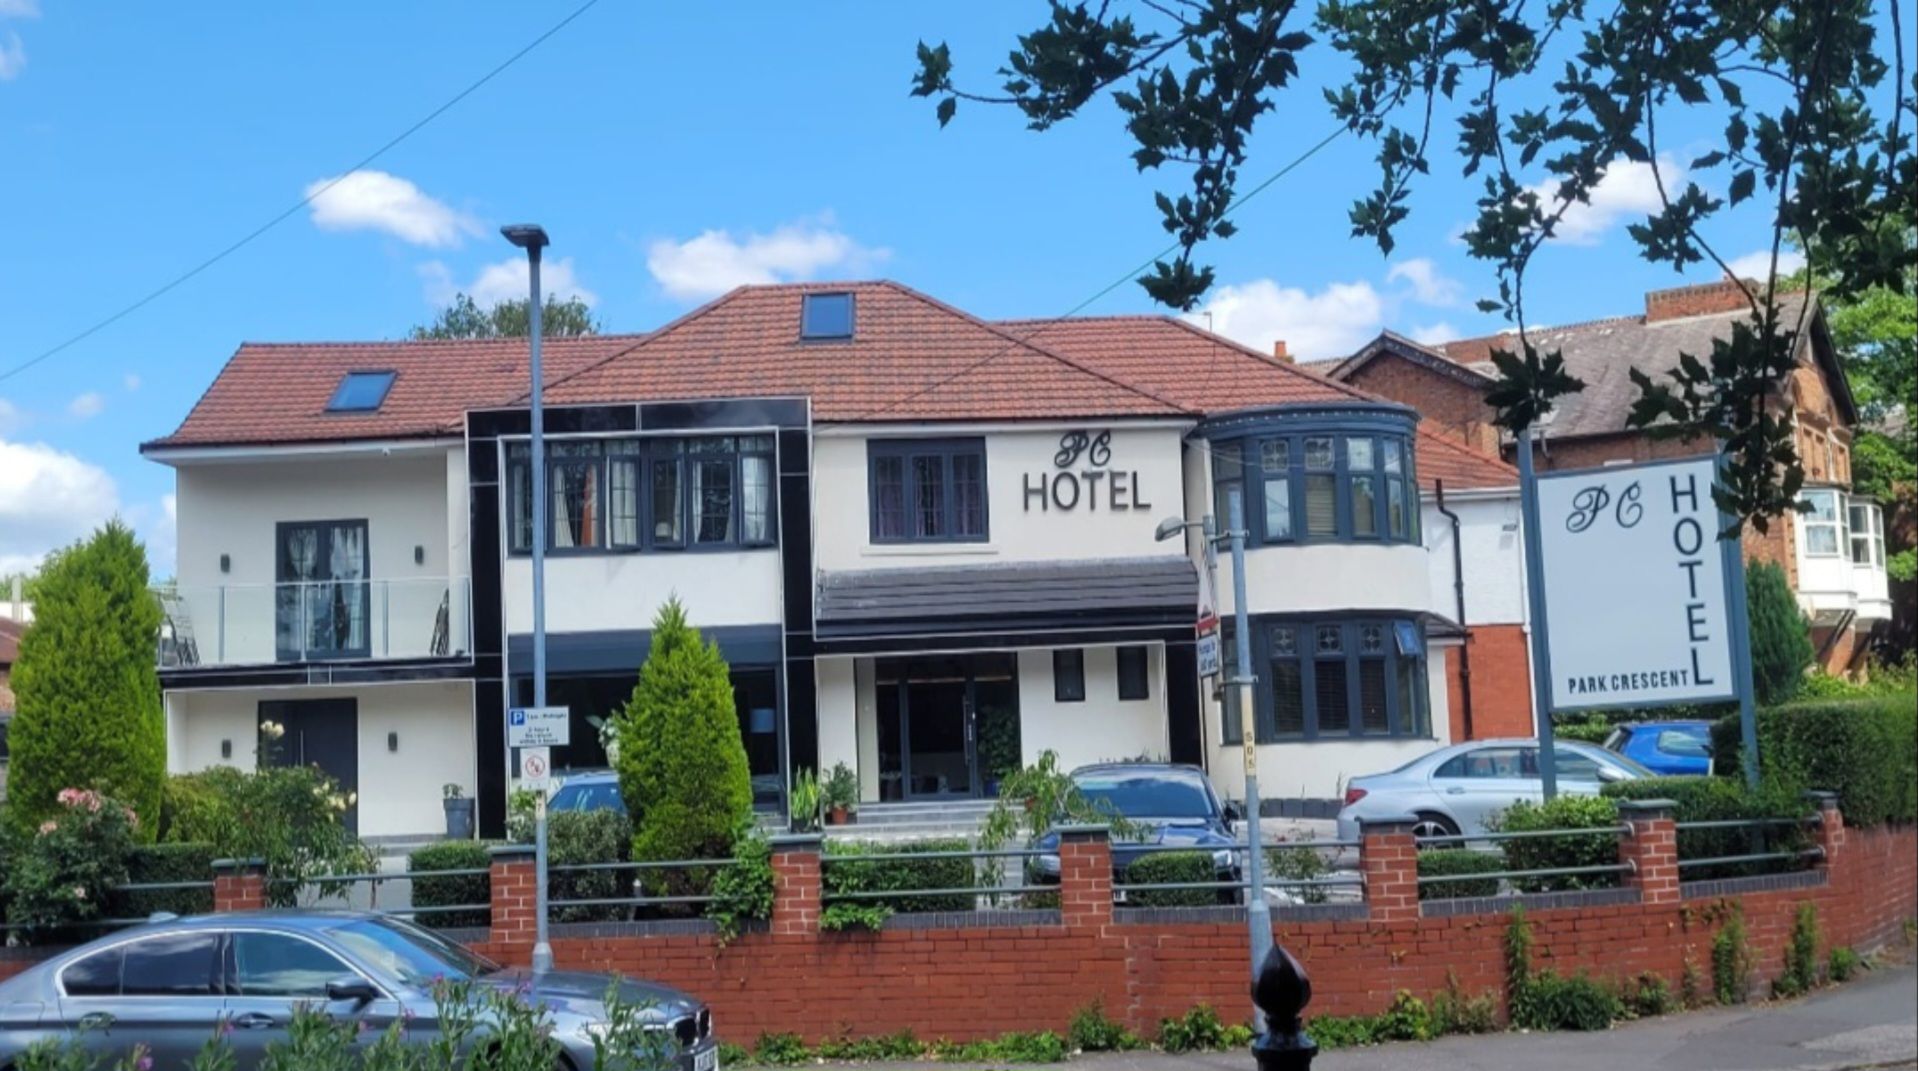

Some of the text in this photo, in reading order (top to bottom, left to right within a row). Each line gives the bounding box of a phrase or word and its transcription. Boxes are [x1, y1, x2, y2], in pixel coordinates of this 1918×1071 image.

[1022, 471, 1152, 511] HOTEL
[1669, 474, 1714, 686] HOTEL
[1568, 669, 1689, 694] PARK CRESCENT
